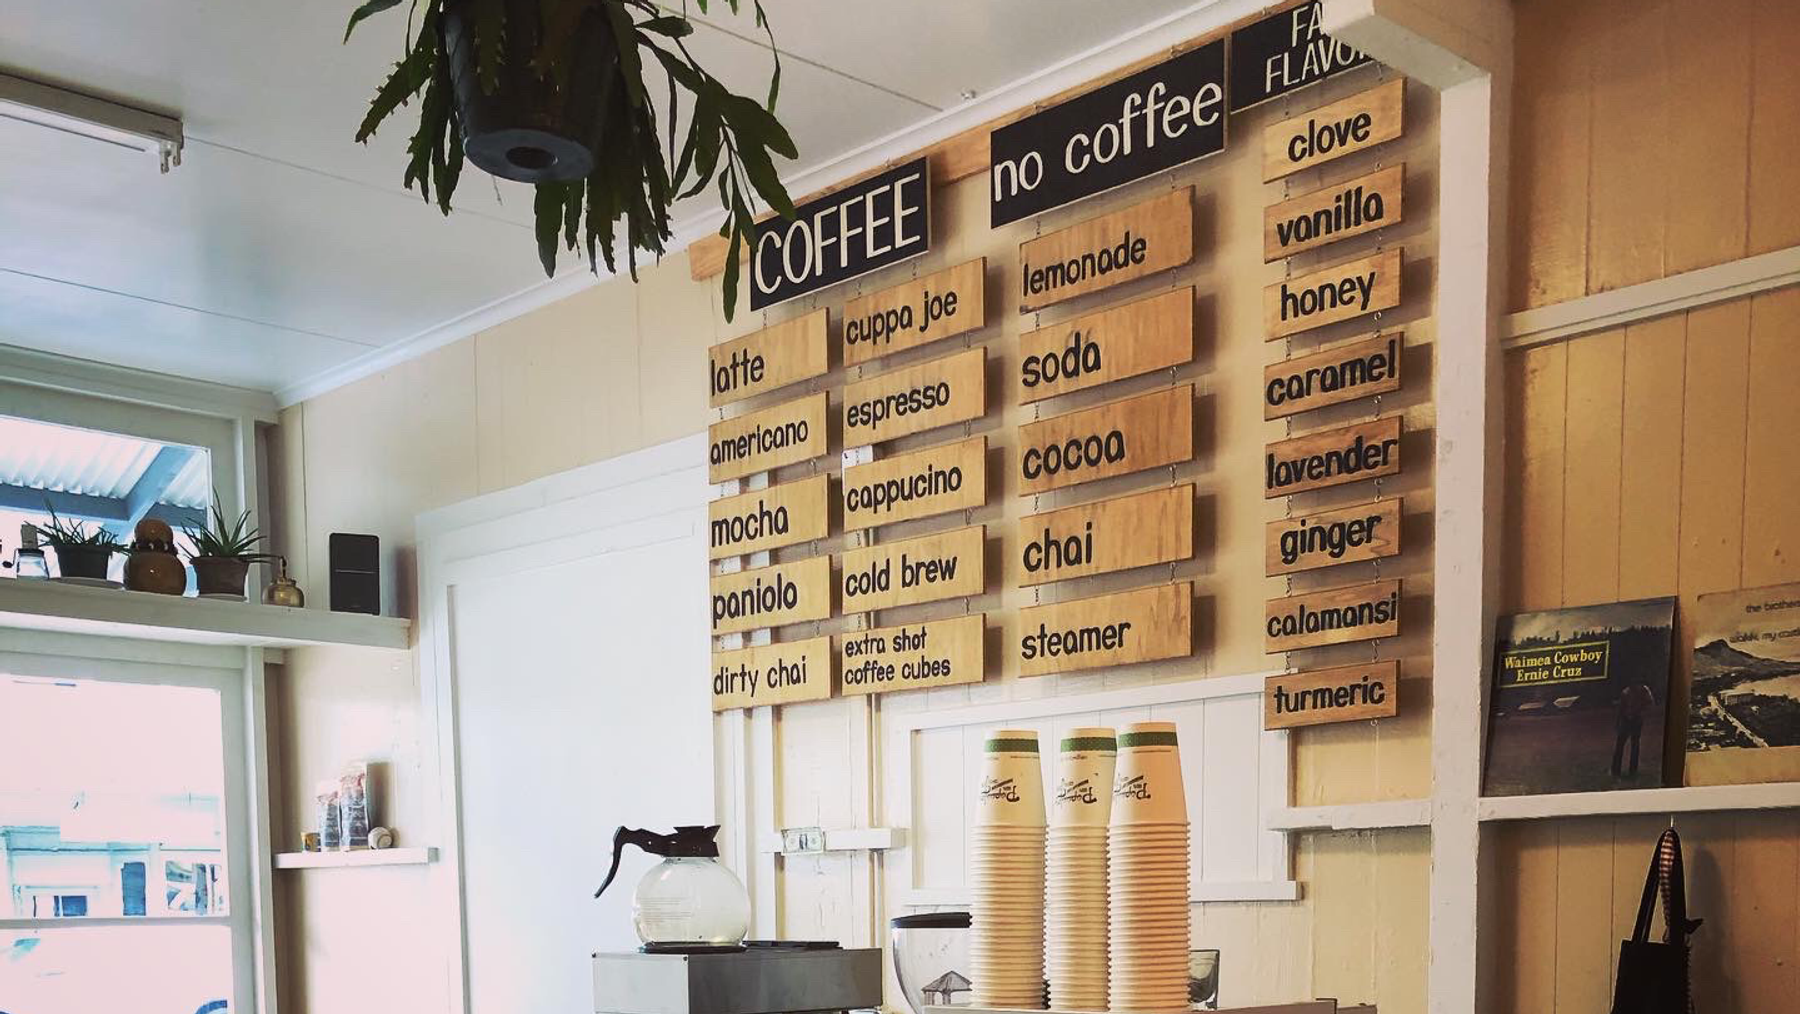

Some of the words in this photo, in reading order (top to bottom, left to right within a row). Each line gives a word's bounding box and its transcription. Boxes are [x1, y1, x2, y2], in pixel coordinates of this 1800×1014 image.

[1292, 2, 1324, 47] FA
[1266, 36, 1371, 93] FLAVO
[994, 151, 1043, 202] no
[1065, 81, 1223, 174] coffee
[1288, 113, 1371, 162] clove
[755, 173, 921, 295] COFFEE
[1276, 186, 1384, 247] vanilla
[1023, 230, 1147, 297] lemonade
[846, 304, 913, 345] cuppa
[919, 290, 958, 332] joe
[1281, 271, 1375, 321] honey
[711, 348, 765, 397] latte
[1022, 331, 1101, 387] soda
[1267, 339, 1396, 406] caramel
[846, 381, 950, 430] espresso
[710, 420, 809, 466] americano
[1022, 430, 1125, 480] cocoa
[1267, 436, 1398, 489] lavender
[846, 464, 963, 514] cappucino
[711, 500, 789, 548] mocha
[1023, 521, 1093, 572] chai
[1280, 515, 1382, 565] ginger
[845, 558, 890, 597] cold
[901, 554, 958, 588] brew
[713, 573, 798, 629] paniolo
[1267, 592, 1397, 637] calamansi
[845, 635, 886, 658] extra
[893, 626, 928, 651] shot
[1021, 622, 1131, 660] steamer
[1504, 655, 1551, 669] Waimea
[1554, 649, 1603, 664] Cowboy
[713, 663, 759, 697] dirty
[767, 655, 807, 689] chai
[845, 661, 895, 685] coffee
[901, 655, 951, 679] cubes
[1516, 668, 1549, 683] Ernie
[1553, 665, 1582, 679] Cruz
[1274, 676, 1386, 714] turmeric
